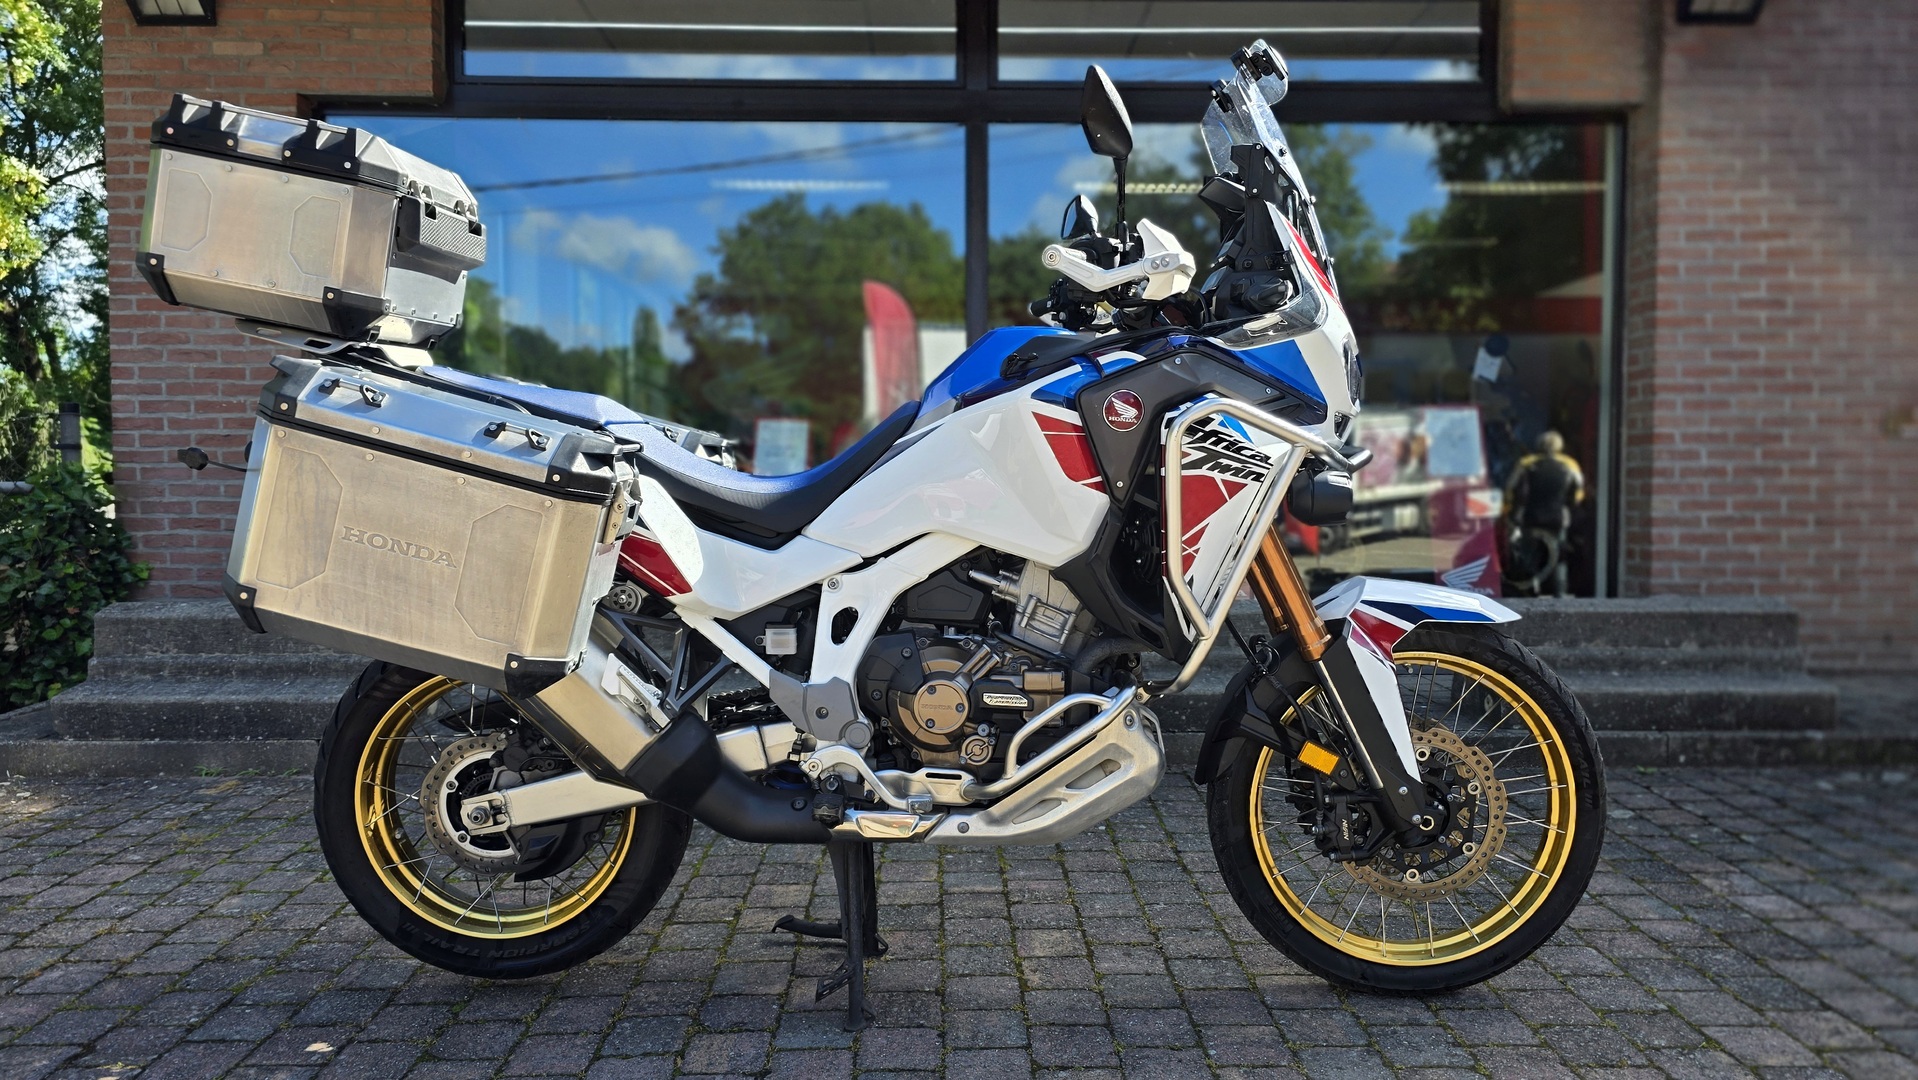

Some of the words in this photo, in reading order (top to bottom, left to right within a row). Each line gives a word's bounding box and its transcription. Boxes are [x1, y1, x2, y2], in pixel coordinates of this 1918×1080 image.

[1108, 416, 1138, 424] HONDA
[341, 525, 458, 569] HONDA
[920, 703, 954, 711] HONDA
[423, 931, 480, 958] TRAIL
